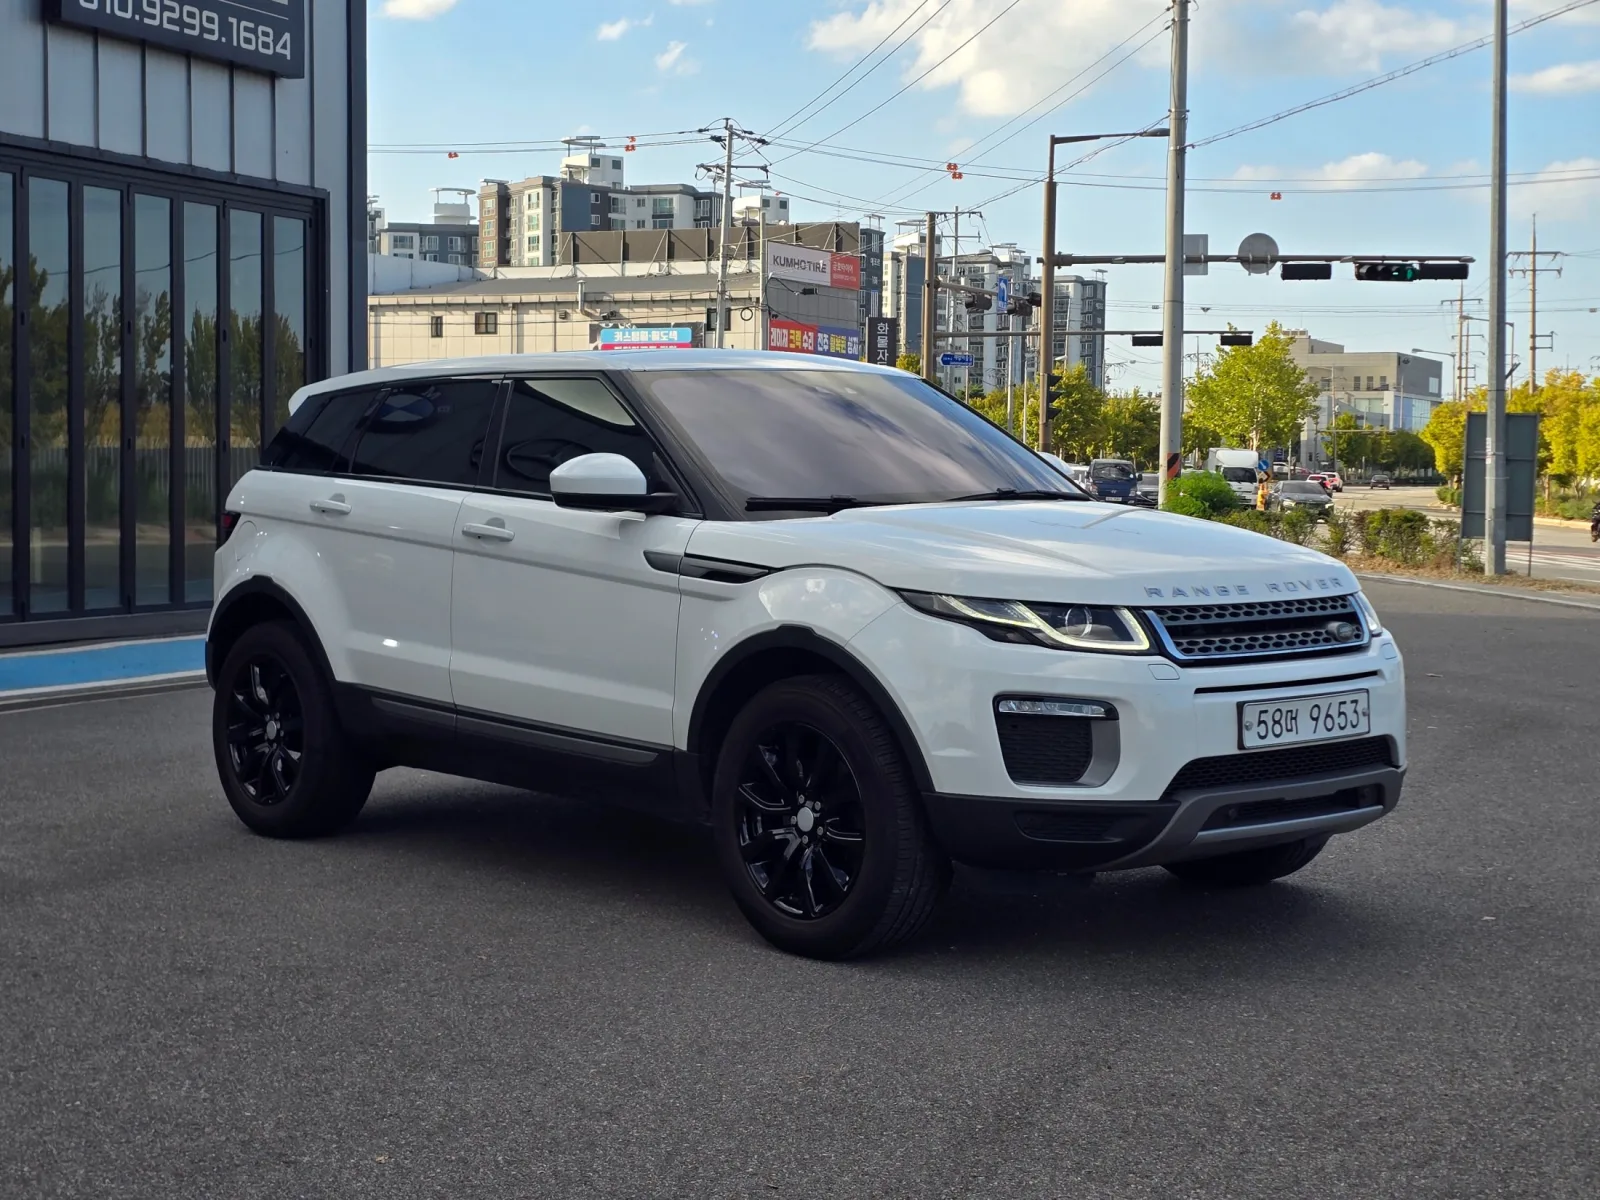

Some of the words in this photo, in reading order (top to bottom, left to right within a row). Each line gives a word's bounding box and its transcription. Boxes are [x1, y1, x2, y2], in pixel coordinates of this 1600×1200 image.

[773, 255, 806, 270] KUMHO
[807, 260, 826, 273] TIRE
[789, 329, 802, 349] 크랙
[803, 331, 814, 350] 수리
[818, 332, 829, 352] 전주
[877, 322, 889, 366] 화물자
[1144, 584, 1250, 598] RANGE
[1265, 577, 1344, 593] ROVER
[1257, 707, 1299, 740] 58머
[1310, 699, 1360, 734] 9653
